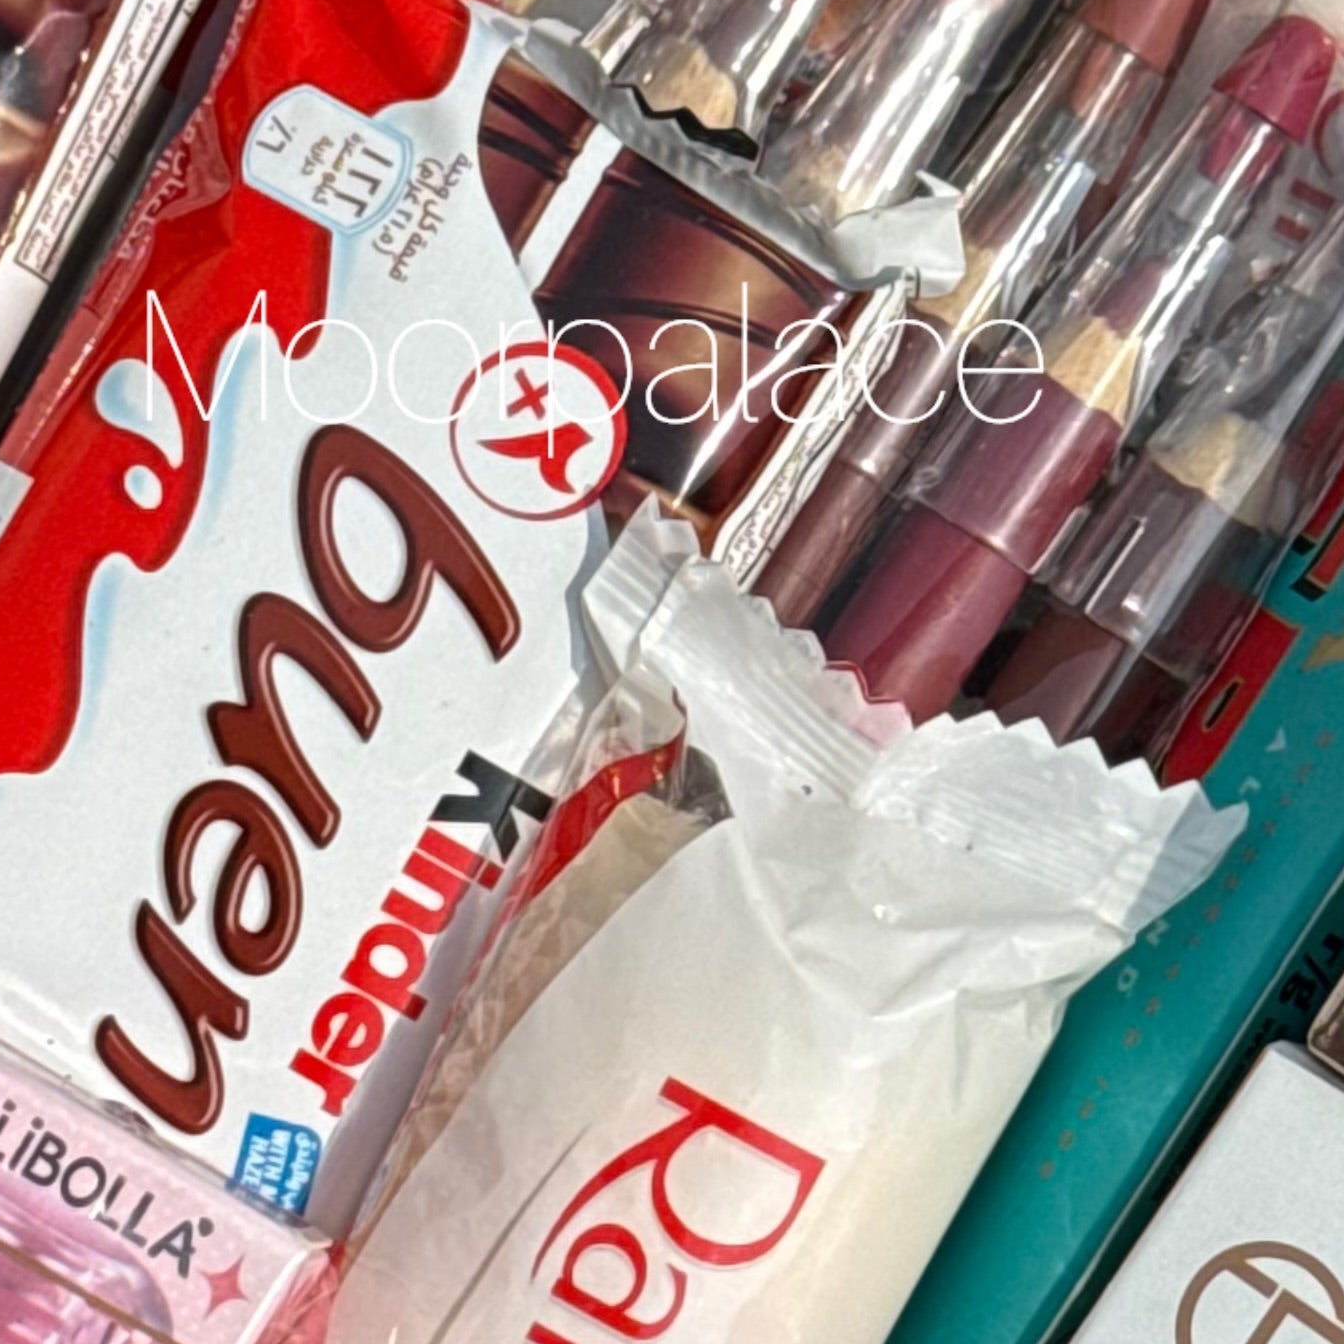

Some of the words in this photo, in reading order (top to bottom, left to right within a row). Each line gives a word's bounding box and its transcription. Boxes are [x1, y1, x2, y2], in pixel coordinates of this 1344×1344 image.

[94, 424, 520, 1136] buen
[1117, 727, 1290, 993] ALND
[289, 749, 555, 1117] Kinder
[239, 1134, 271, 1188] HAZE
[260, 1127, 294, 1182] WITH
